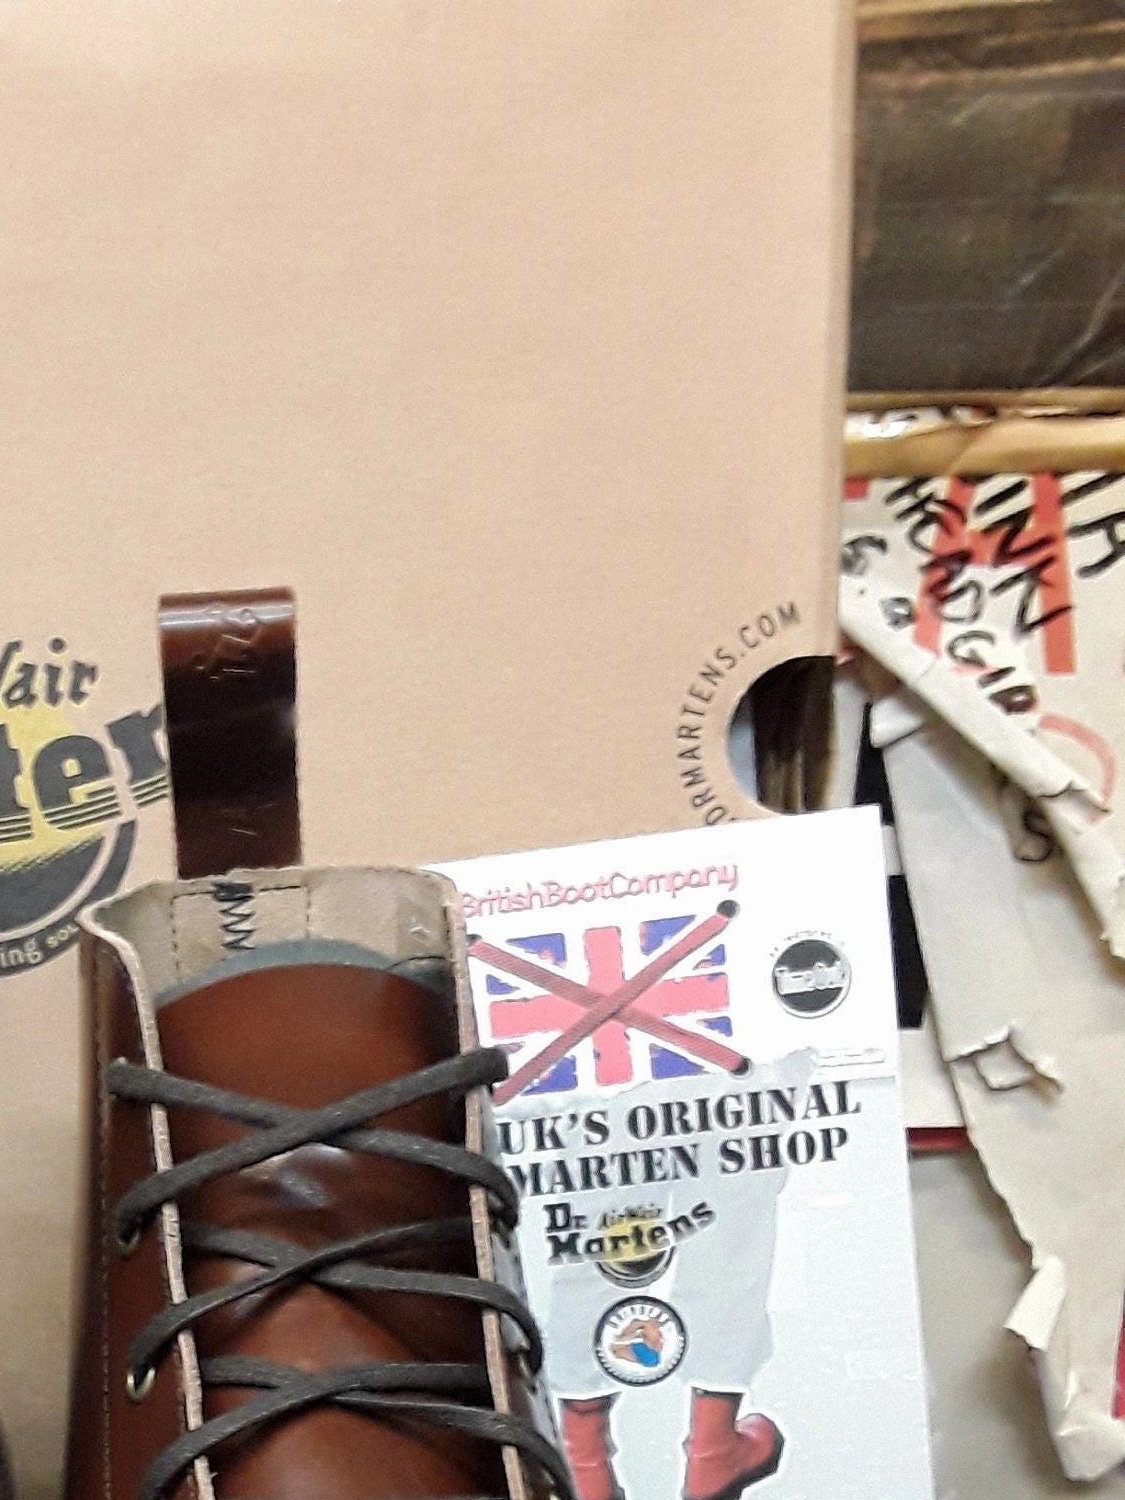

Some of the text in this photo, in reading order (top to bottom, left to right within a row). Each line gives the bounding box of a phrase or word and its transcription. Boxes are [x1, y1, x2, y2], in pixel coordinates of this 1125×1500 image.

[495, 1081, 861, 1156] UK'S ORIGINAL
[506, 1126, 849, 1196] MARTEN SHOP
[546, 1202, 716, 1266] Martens
